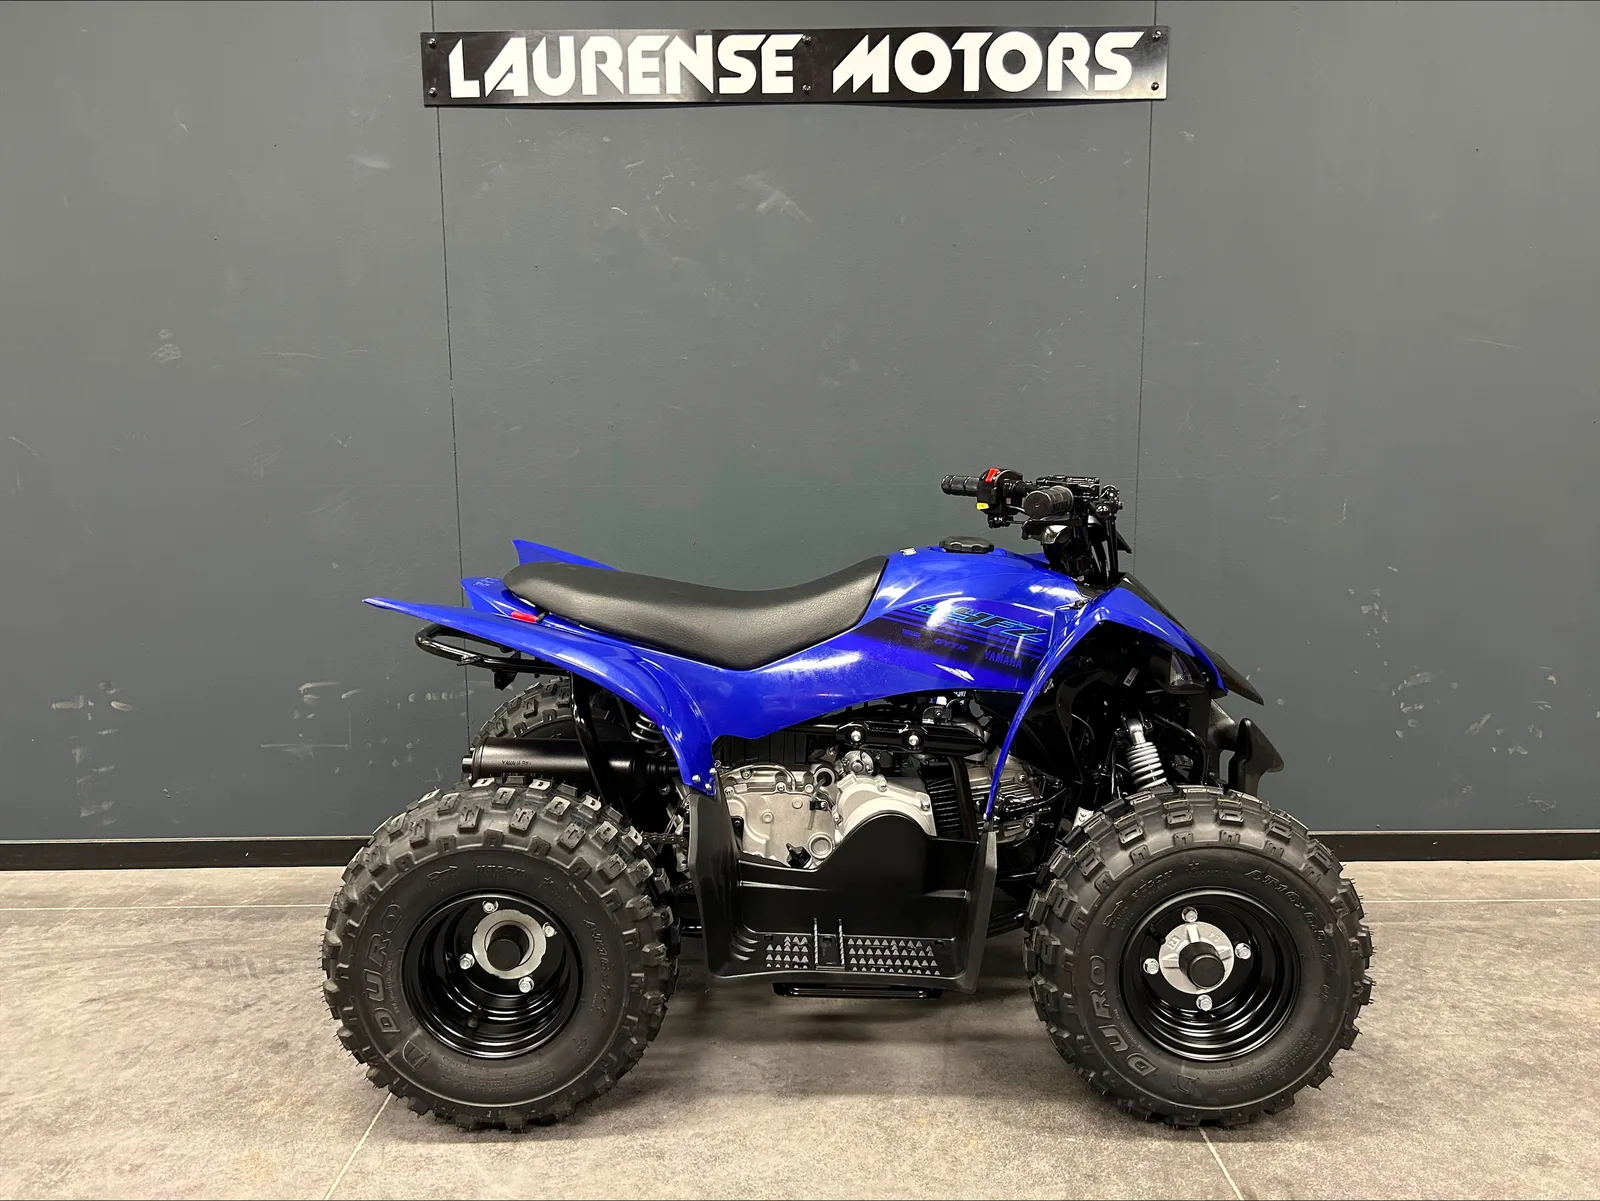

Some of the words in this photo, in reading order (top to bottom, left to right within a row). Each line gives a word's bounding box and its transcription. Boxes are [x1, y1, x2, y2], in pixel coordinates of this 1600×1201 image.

[448, 34, 805, 98] LAURENSE
[832, 30, 1144, 94] MOTORS
[948, 607, 1047, 642] YFZ
[984, 650, 1022, 668] YAMAHA
[364, 903, 404, 1034] DURO
[1088, 954, 1159, 1077] DURO
